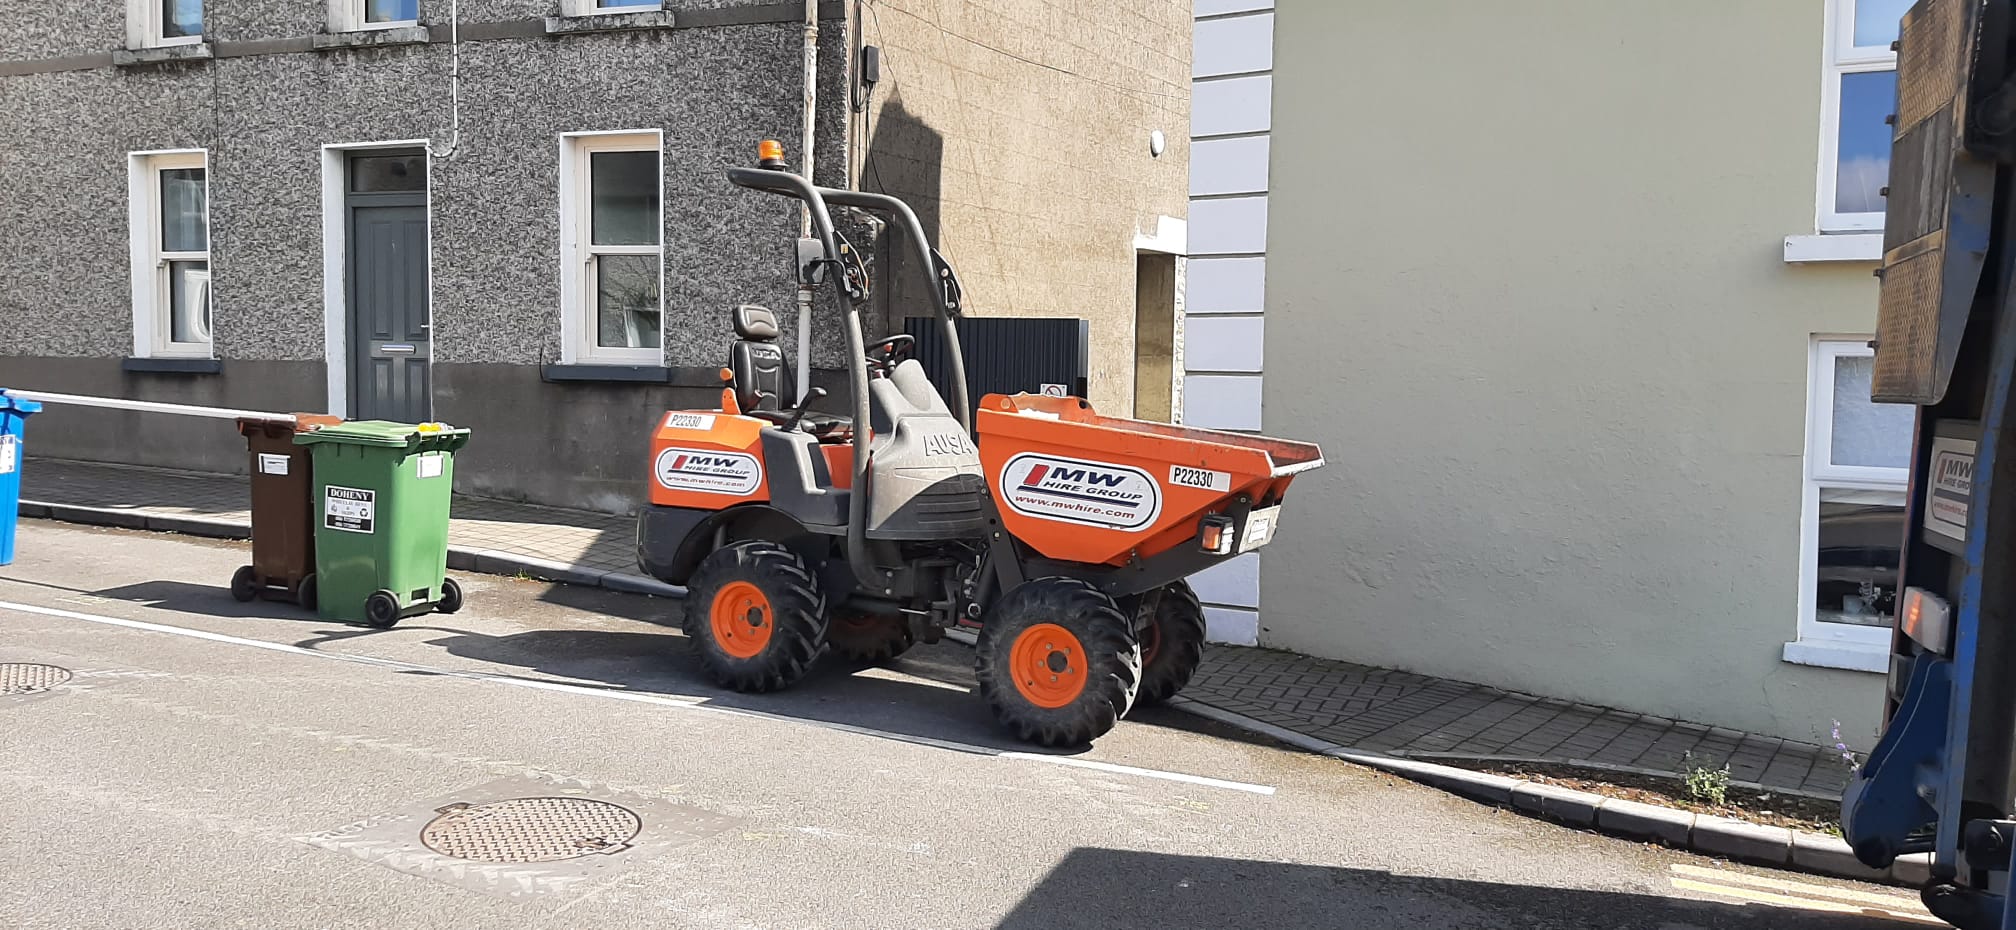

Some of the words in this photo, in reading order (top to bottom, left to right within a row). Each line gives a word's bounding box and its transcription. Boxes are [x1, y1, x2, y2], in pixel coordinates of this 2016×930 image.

[670, 414, 702, 427] P22330
[923, 432, 973, 456] AUSA
[689, 456, 739, 467] MW
[1946, 460, 1973, 478] MW
[1050, 467, 1127, 487] MW
[1173, 467, 1213, 488] P22330
[330, 489, 369, 500] DOHENY
[1043, 481, 1081, 492] HIRE
[1086, 487, 1143, 500] GROUP
[1015, 495, 1135, 519] www.mwhire.com
